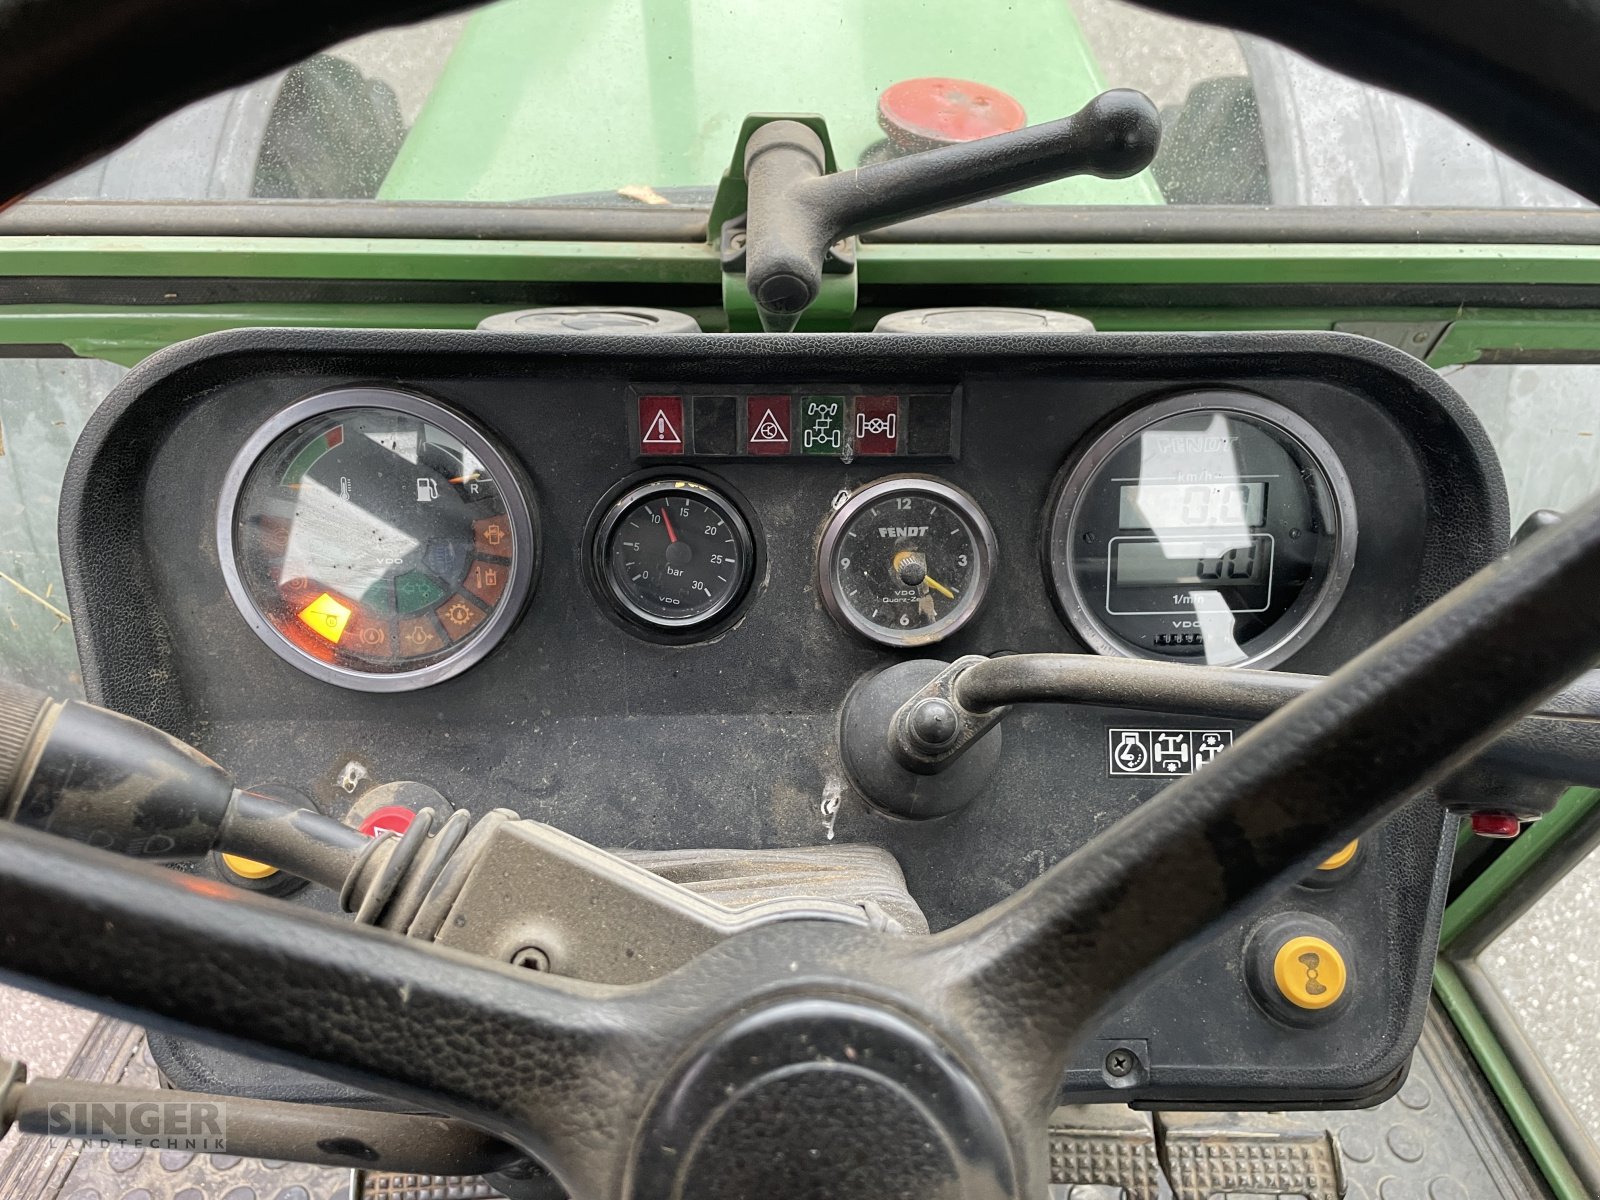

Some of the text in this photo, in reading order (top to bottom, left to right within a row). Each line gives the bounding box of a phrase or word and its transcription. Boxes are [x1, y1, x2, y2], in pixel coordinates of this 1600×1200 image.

[1157, 436, 1239, 453] FENDT
[1178, 470, 1212, 482] km/h
[470, 483, 479, 494] R
[896, 498, 912, 510] 12
[679, 507, 690, 517] 15
[651, 514, 661, 524] 10
[704, 525, 717, 536] 20
[878, 526, 929, 537] FENDT
[633, 542, 640, 552] 5
[376, 557, 403, 565] VDO
[710, 554, 722, 564] 25
[840, 557, 850, 570] 9
[958, 554, 968, 567] 3
[642, 570, 649, 580] 0
[667, 566, 684, 577] bar
[691, 580, 704, 590] 30
[658, 596, 680, 605] VDO
[1172, 593, 1205, 606] 1/min
[900, 613, 910, 626] 6
